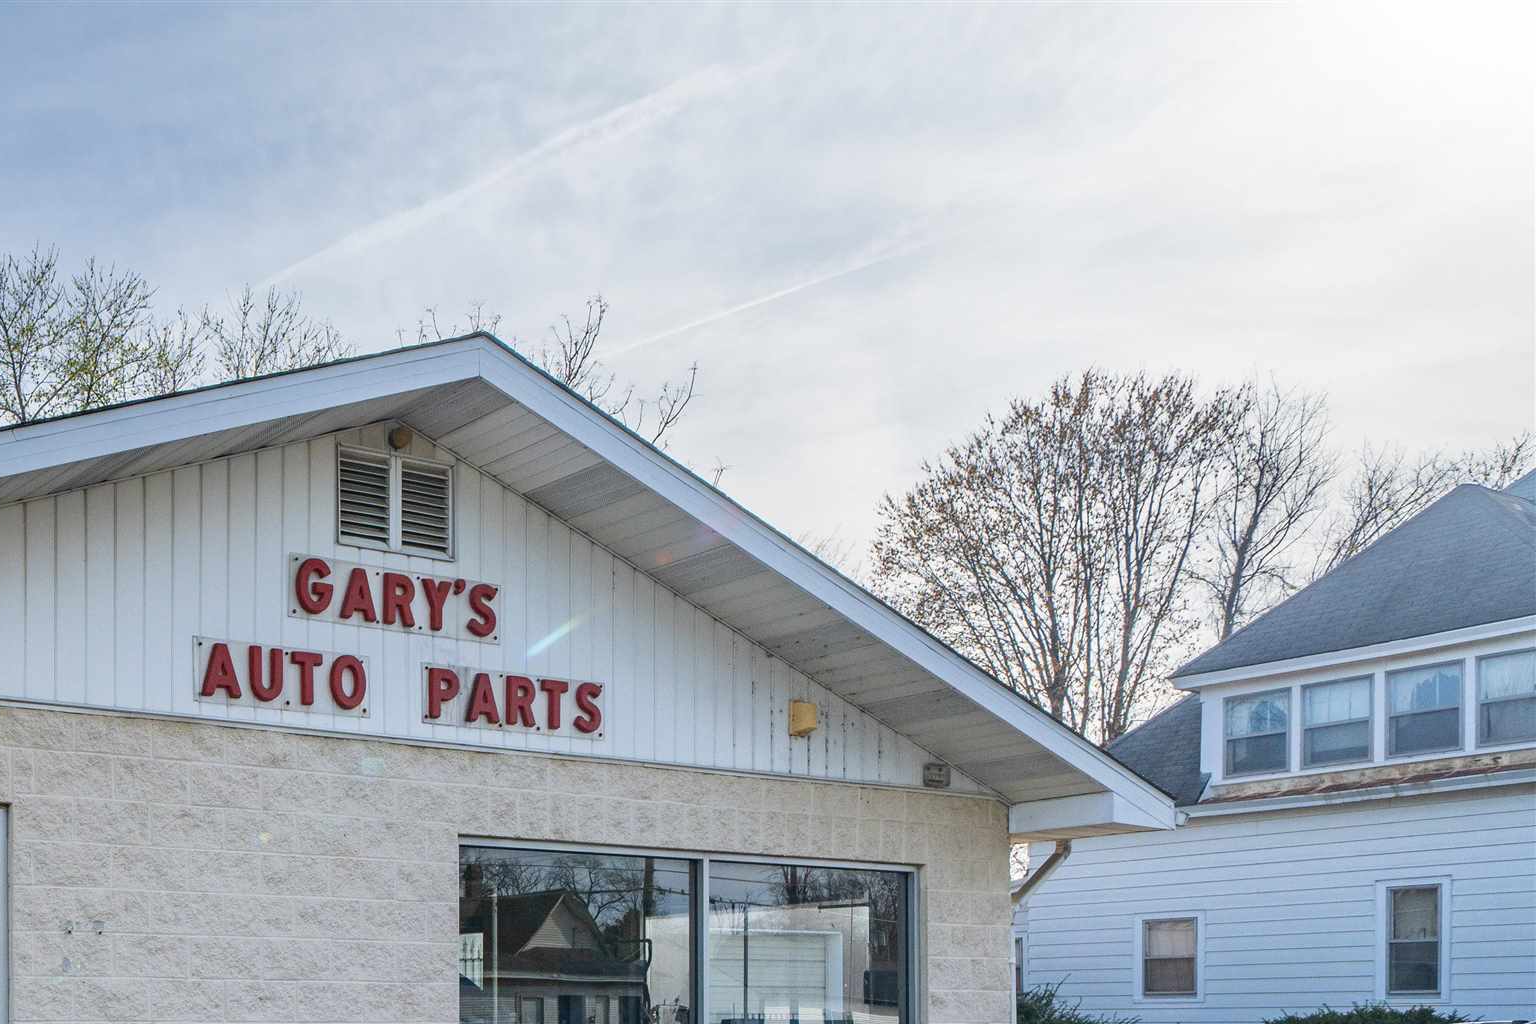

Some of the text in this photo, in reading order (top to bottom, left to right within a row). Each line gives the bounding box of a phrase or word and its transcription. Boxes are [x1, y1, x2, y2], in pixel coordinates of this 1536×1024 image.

[296, 558, 498, 637] GARY'S
[201, 643, 602, 733] AUTO PARTS
